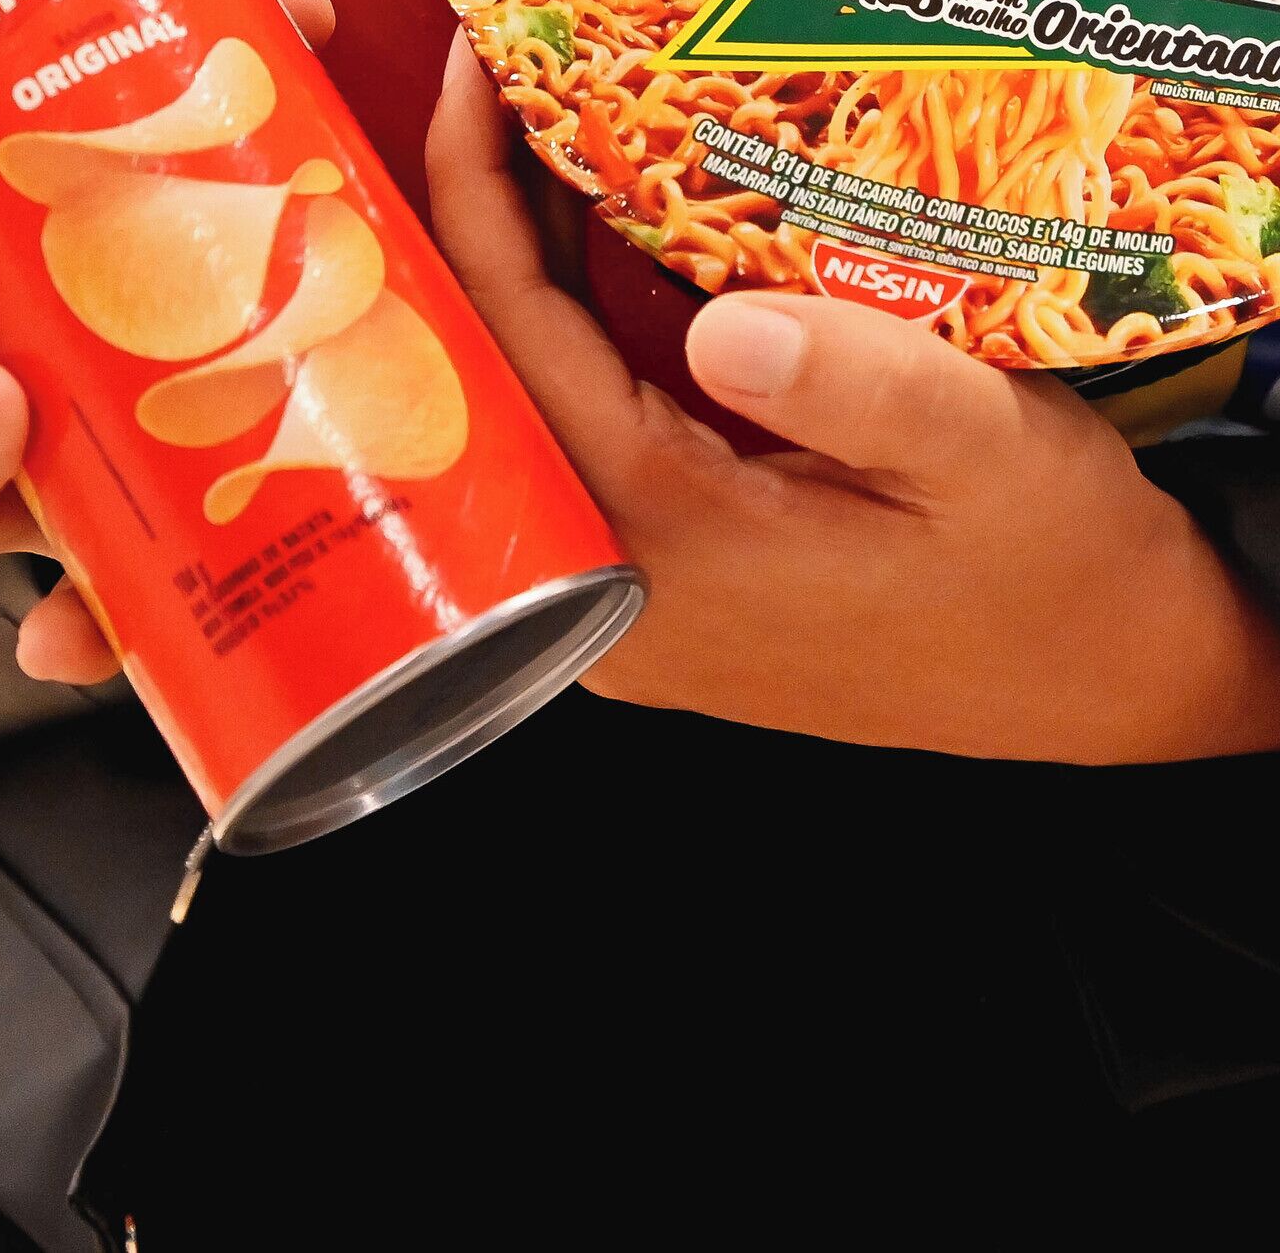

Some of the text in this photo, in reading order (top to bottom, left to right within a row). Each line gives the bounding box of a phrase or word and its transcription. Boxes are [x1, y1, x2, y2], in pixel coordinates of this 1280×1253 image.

[947, 0, 1028, 36] molho
[11, 12, 188, 111] ORIGINAL
[1150, 79, 1217, 105] INDÚSTRIA
[694, 119, 1174, 255] CONTÉM 81g DE MACARRÃO COM FLOCOS E 14g DE MOLHO
[702, 152, 1145, 277] MACARRÃO INSTANTÂNEO COM MOLHO SABOR LEGUMES
[780, 211, 1037, 282] CONTÉM AROMATIZANTE SINTÉTICO IDÊNTICO AO NATURAL
[822, 256, 945, 306] NISSIN
